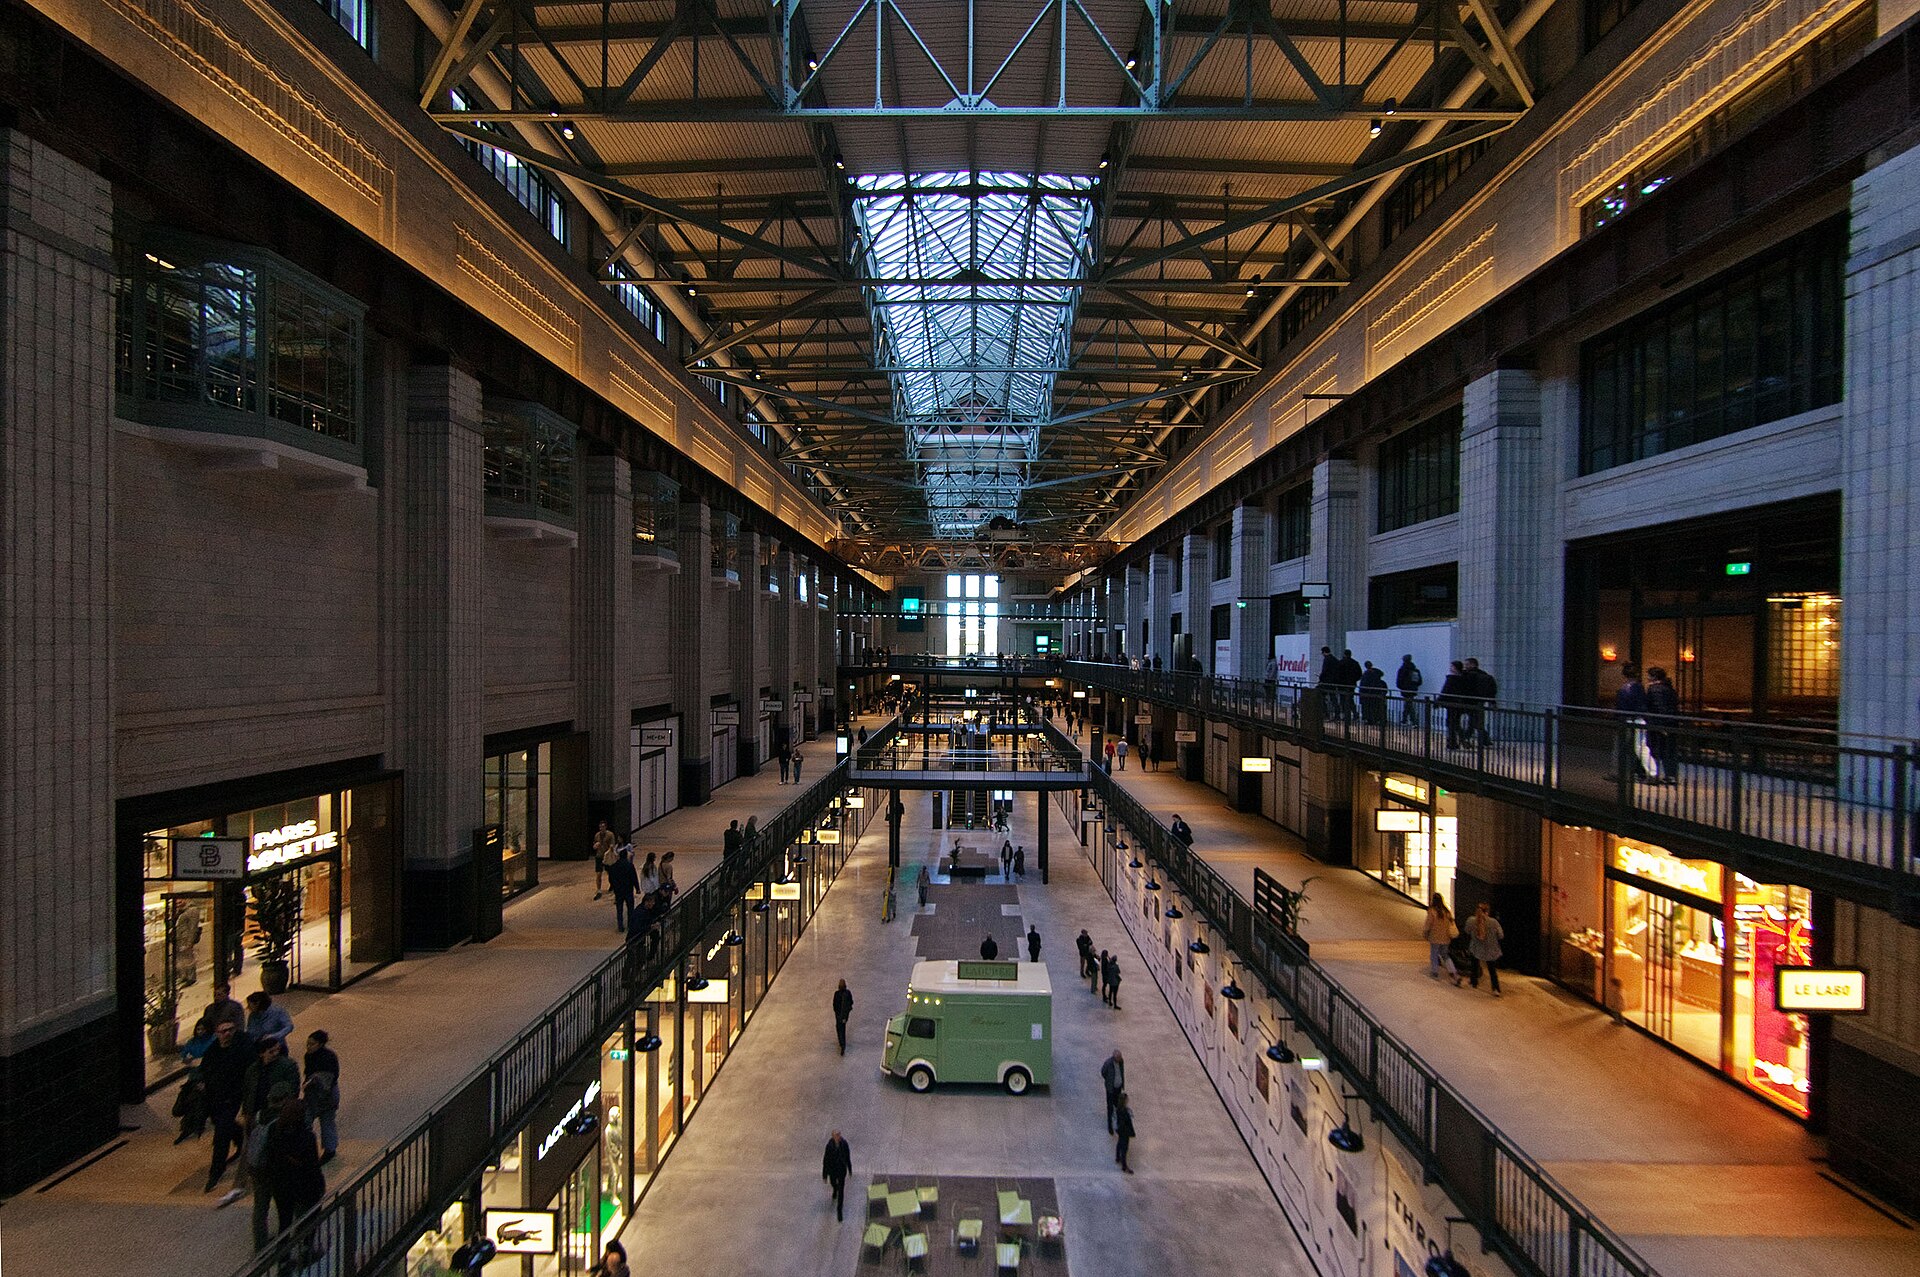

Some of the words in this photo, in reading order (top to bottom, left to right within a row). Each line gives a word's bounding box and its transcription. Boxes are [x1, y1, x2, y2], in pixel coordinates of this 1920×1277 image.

[253, 819, 317, 850] PARIS
[247, 831, 339, 871] AGUETTE
[1794, 983, 1811, 996] LE
[1815, 983, 1851, 997] LABO
